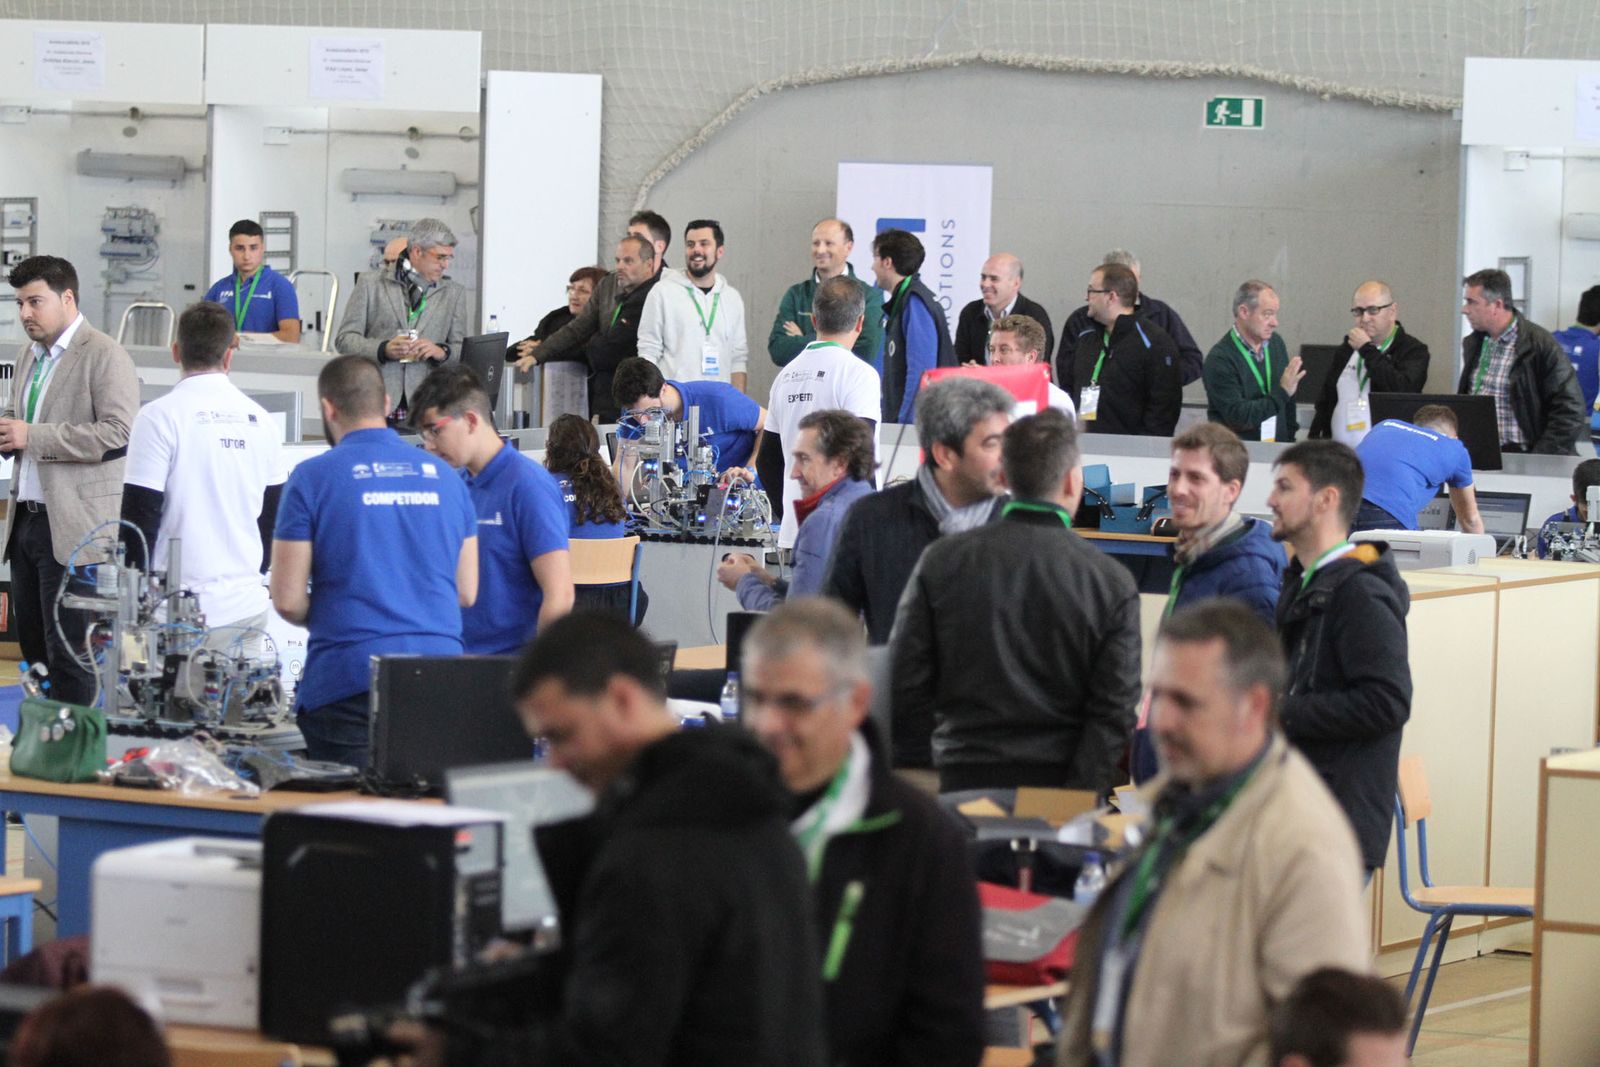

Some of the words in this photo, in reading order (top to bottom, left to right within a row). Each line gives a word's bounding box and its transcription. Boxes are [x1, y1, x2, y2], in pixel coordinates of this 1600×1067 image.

[938, 218, 956, 327] OTIONS
[219, 437, 246, 450] TUTOR
[362, 492, 439, 506] COMPETIDOR
